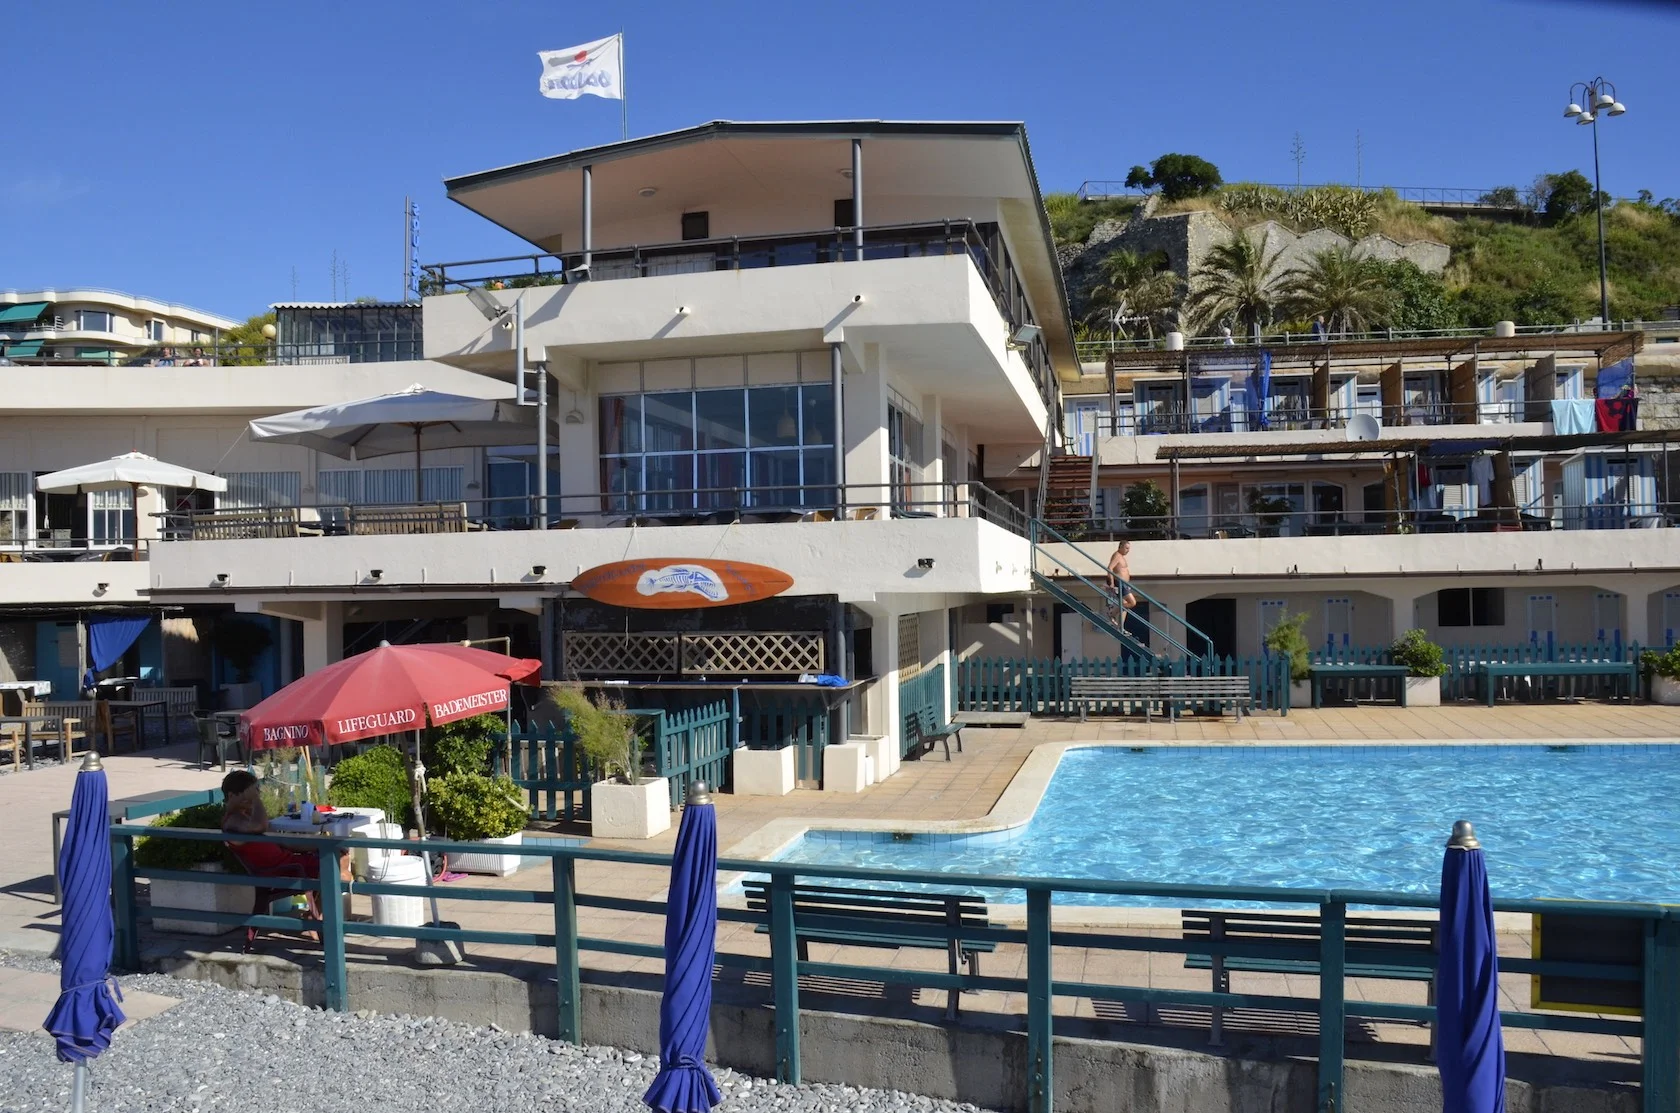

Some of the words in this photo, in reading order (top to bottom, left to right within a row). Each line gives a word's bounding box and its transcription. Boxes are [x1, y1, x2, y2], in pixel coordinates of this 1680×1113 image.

[411, 202, 420, 293] SQUASH
[433, 688, 508, 719] BADEMEISTER
[263, 724, 309, 742] BAGNINO
[337, 708, 416, 734] LIFEGUARD
